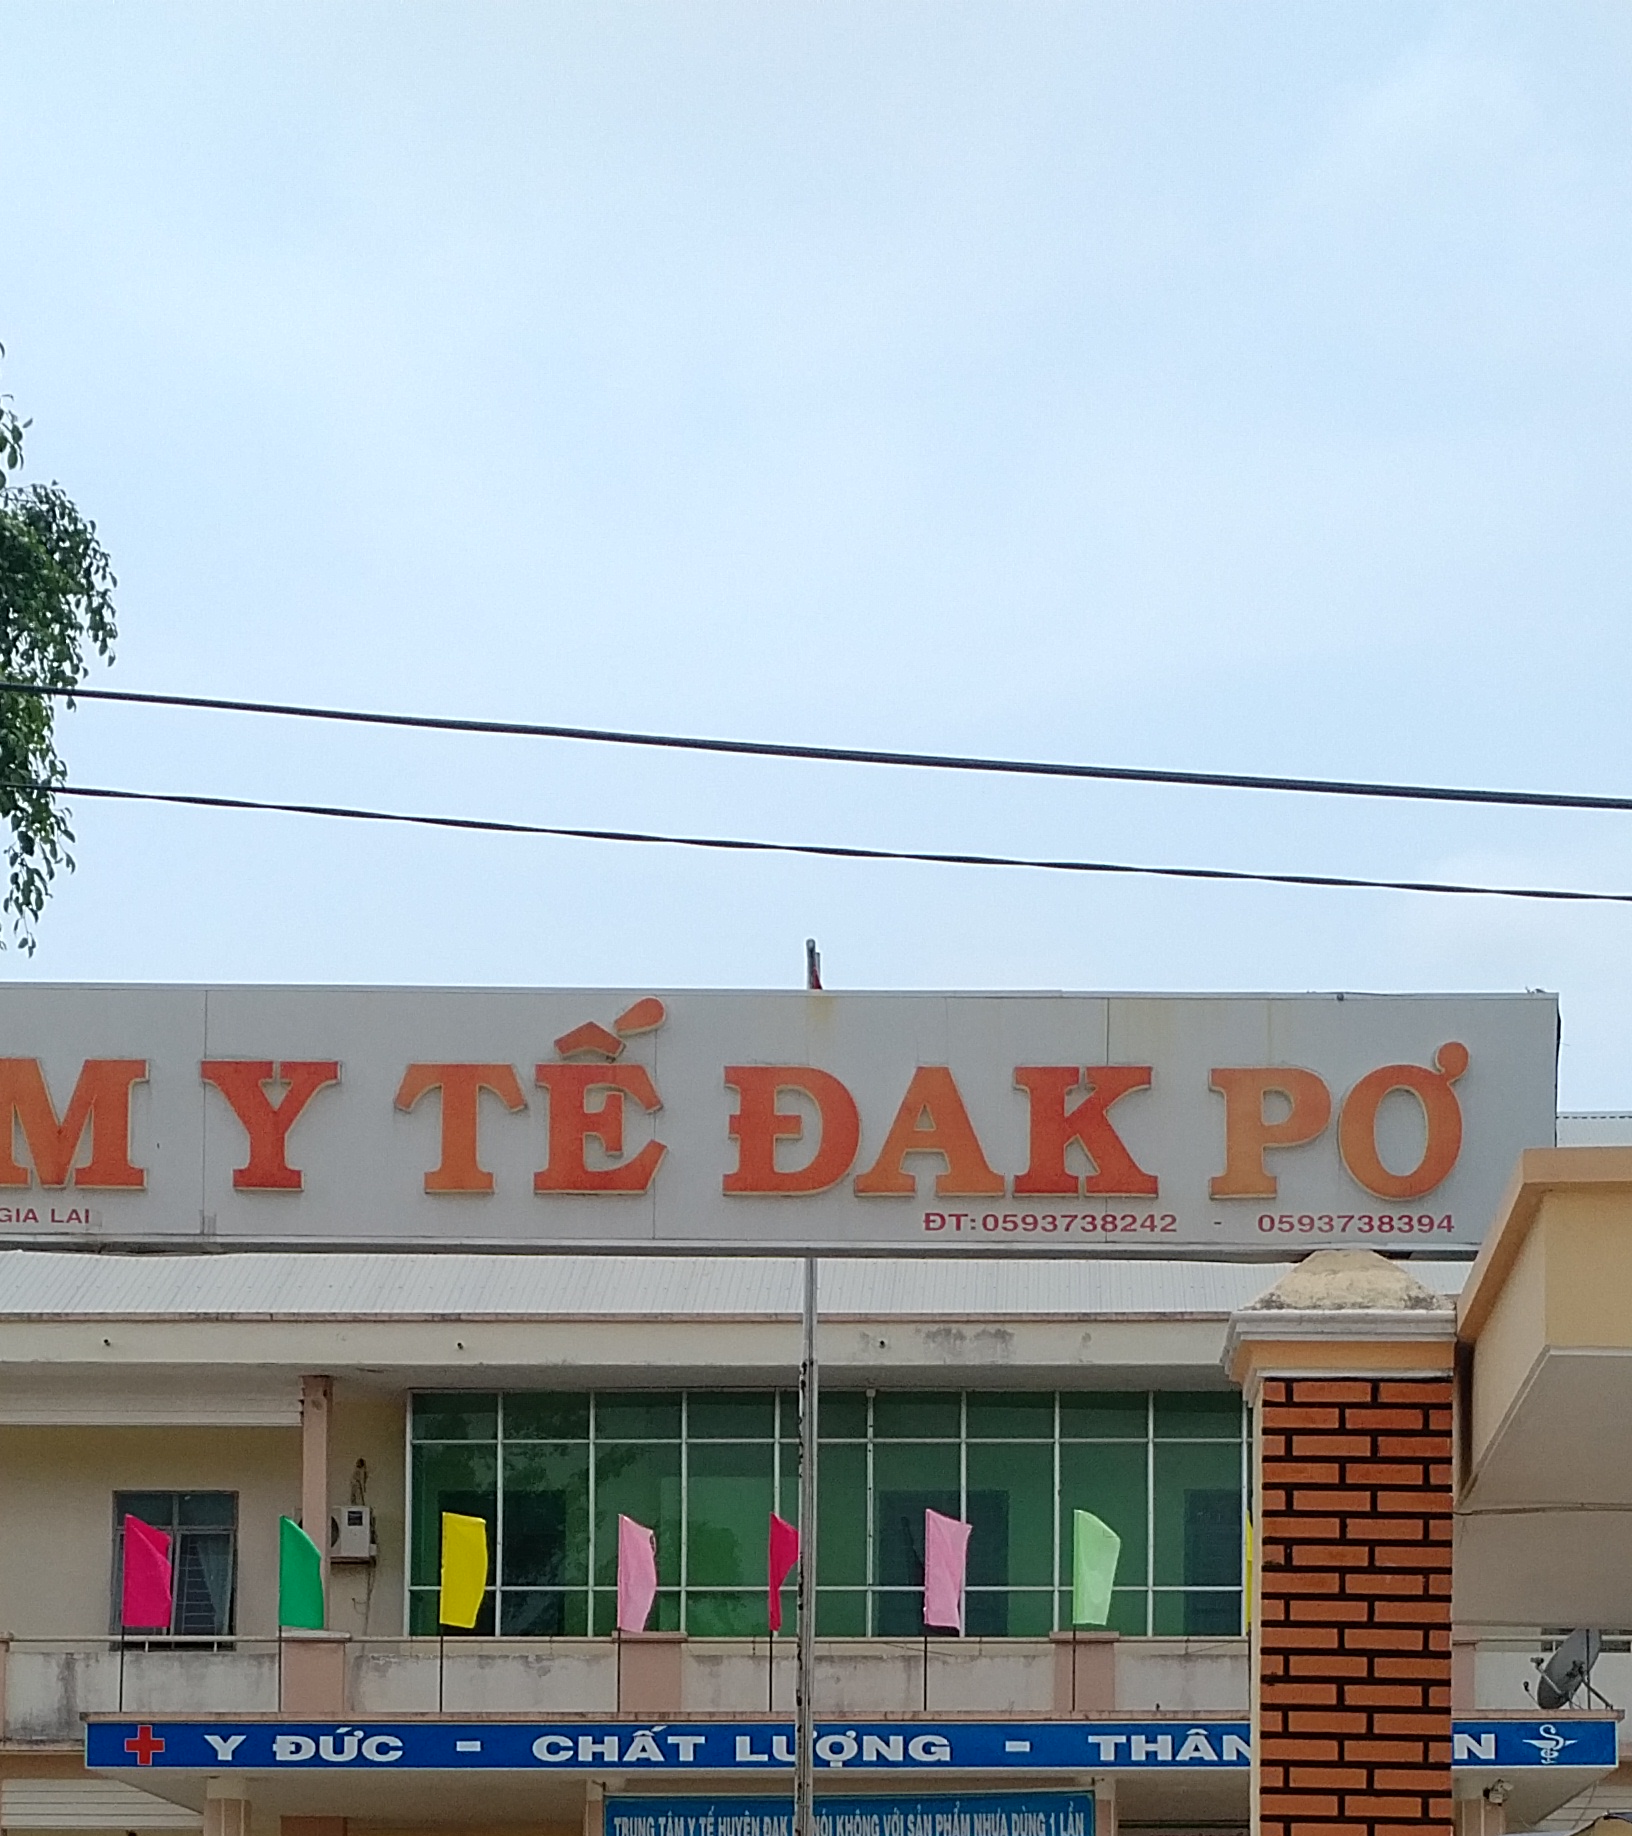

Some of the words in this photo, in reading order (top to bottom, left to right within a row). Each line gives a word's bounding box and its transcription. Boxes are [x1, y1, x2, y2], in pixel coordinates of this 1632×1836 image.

[199, 1057, 343, 1193] Y
[393, 996, 668, 1196] TẾ
[721, 1063, 1161, 1197] ĐAK
[1207, 1040, 1472, 1200] PƠ
[50, 1208, 91, 1225] LAI
[1257, 1213, 1455, 1235] 0593738394
[204, 1735, 247, 1762] Y
[272, 1726, 404, 1763] ĐỨC
[532, 1725, 705, 1763] CHẤT
[1088, 1728, 1251, 1762] THÂN
